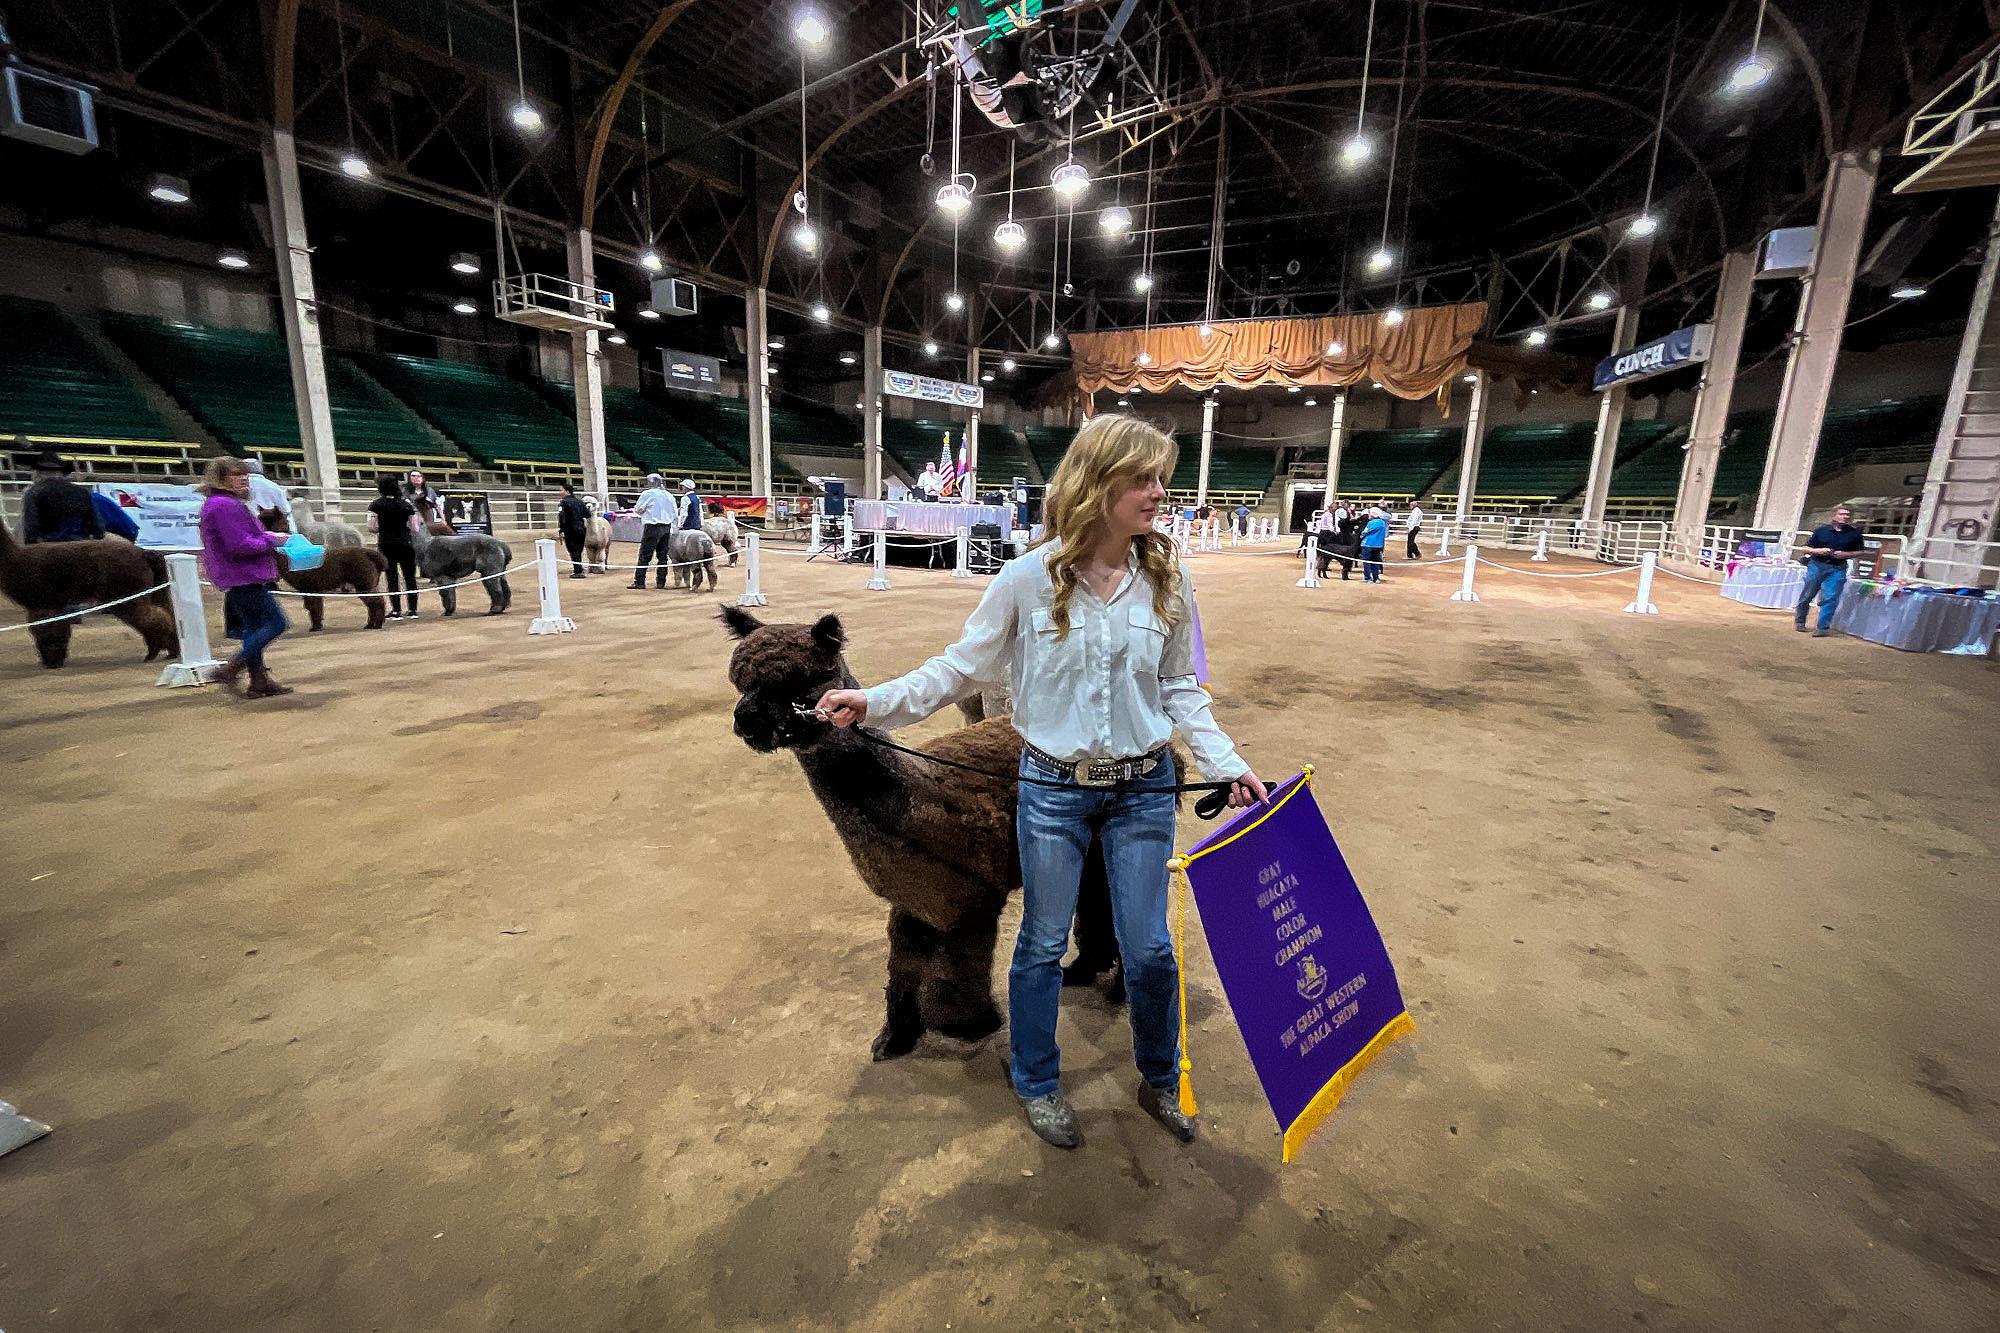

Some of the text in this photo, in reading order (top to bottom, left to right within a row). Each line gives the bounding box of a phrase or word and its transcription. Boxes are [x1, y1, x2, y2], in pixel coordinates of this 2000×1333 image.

[1614, 343, 1665, 376] CINCH
[1259, 860, 1281, 885] GRAY
[1272, 896, 1296, 922] MALE
[1276, 912, 1307, 941] COLOR
[1275, 924, 1323, 967] CHAMPION
[1280, 972, 1367, 1049] THE GREAT WESTERN
[1300, 999, 1359, 1057] ALPACA SHOW
